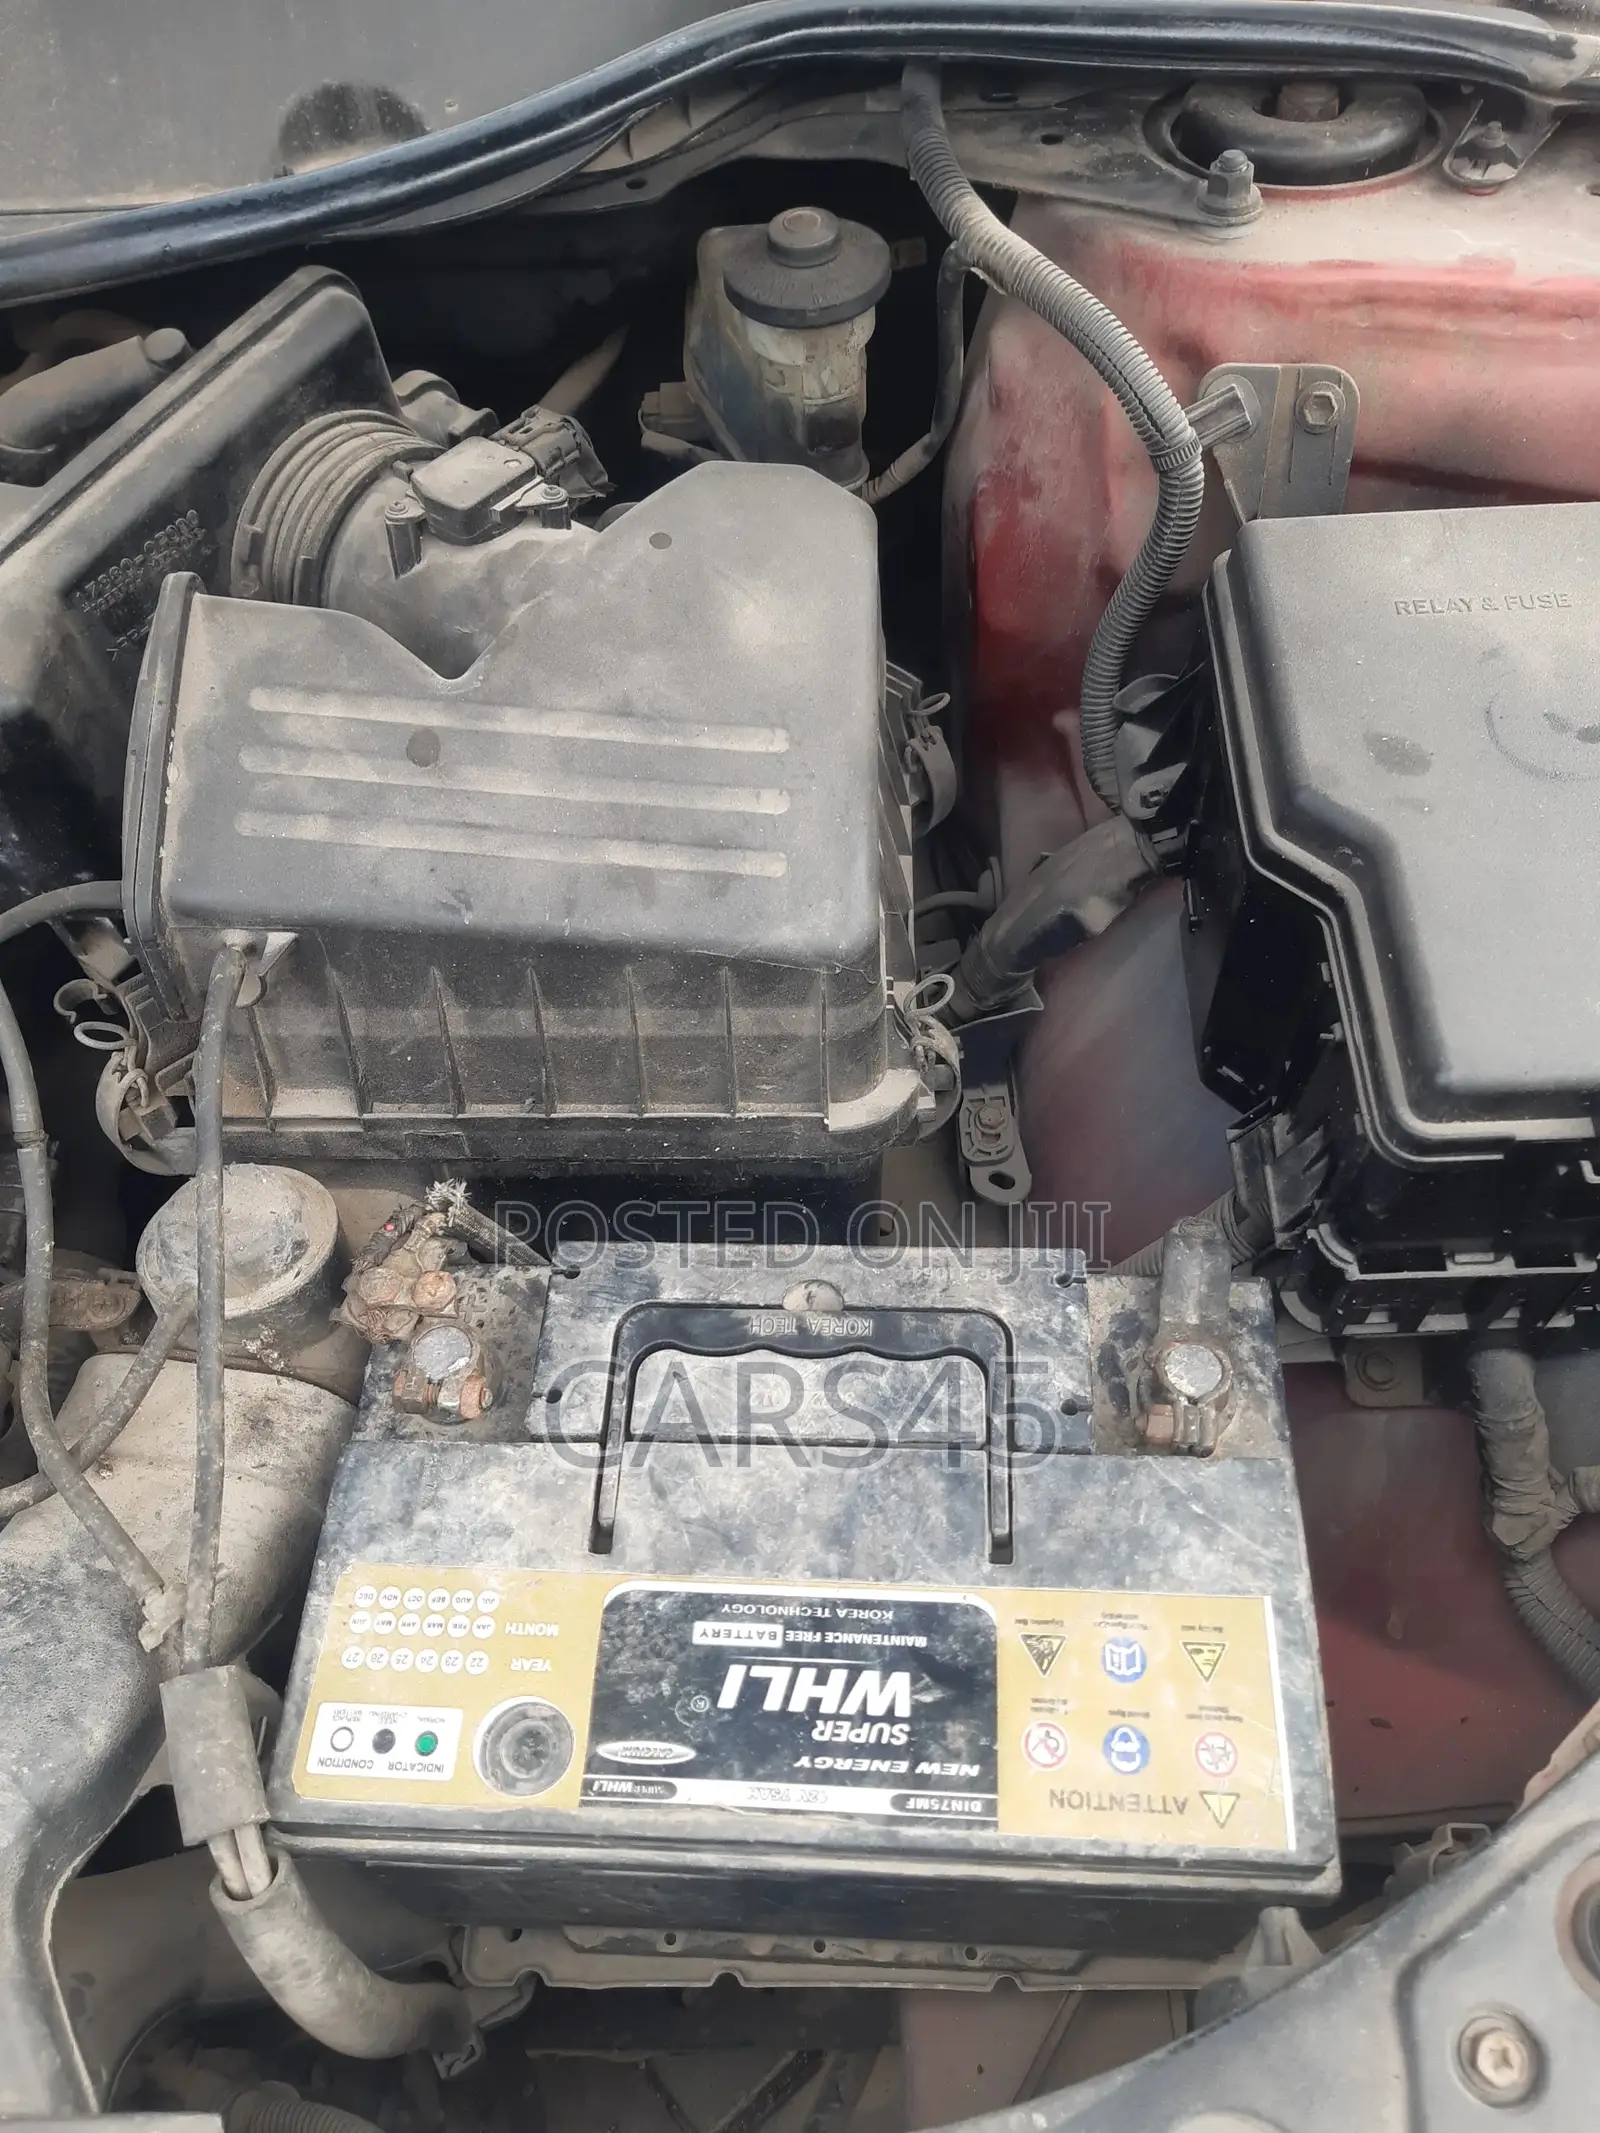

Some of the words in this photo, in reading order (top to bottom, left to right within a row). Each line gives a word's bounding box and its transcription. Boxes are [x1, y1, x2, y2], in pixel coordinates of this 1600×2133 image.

[1393, 597, 1473, 616] RELAY
[1481, 598, 1499, 611] &
[1503, 592, 1573, 611] FUSE
[750, 1317, 798, 1334] TECH
[806, 1317, 873, 1336] KOREA
[358, 1592, 374, 1600] DEC
[721, 1602, 830, 1618] TECHNOLOGY
[836, 1607, 894, 1620] KOREA
[401, 1620, 417, 1628] APR
[505, 1622, 559, 1637] MONTH
[698, 1626, 778, 1642] BATTERY
[785, 1630, 821, 1643] FREE
[824, 1631, 927, 1648] MAINTENANCE
[346, 1652, 360, 1662] 27
[395, 1654, 409, 1664] 25
[420, 1655, 434, 1666] 24
[445, 1656, 459, 1666] 23
[469, 1657, 484, 1668] 22
[510, 1657, 552, 1672] YEAR
[717, 1663, 912, 1718] WHLI
[811, 1720, 910, 1746] SUPER
[317, 1756, 374, 1770] CONDITION
[388, 1761, 444, 1774] INDICATOR
[793, 1755, 909, 1773] ENERGY
[915, 1762, 980, 1776] NEW
[592, 1780, 632, 1793] WHLI
[799, 1789, 828, 1804] 12V
[1049, 1789, 1188, 1815] ATTENTION
[905, 1796, 982, 1814] DIN75MF
